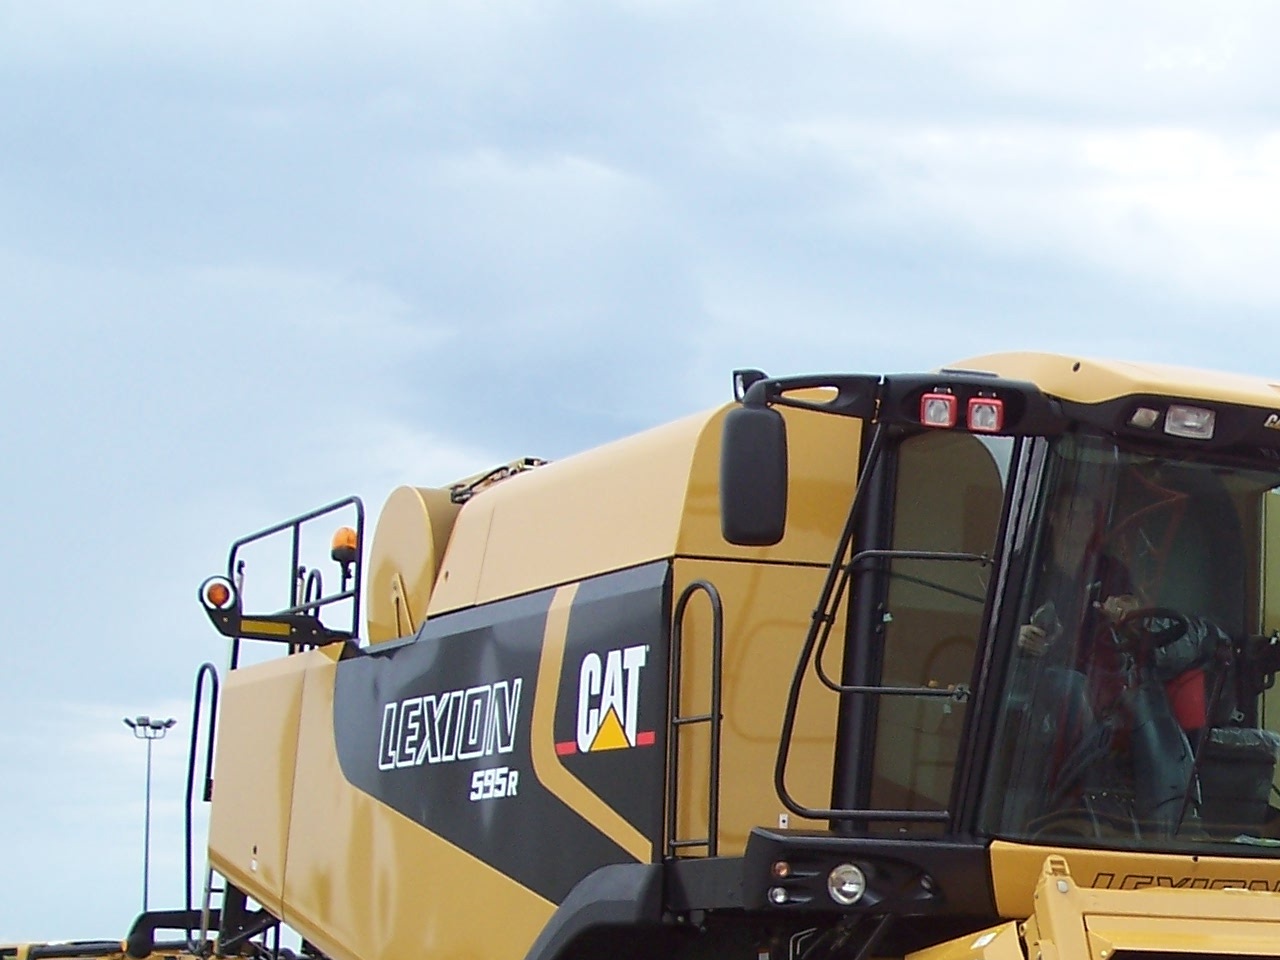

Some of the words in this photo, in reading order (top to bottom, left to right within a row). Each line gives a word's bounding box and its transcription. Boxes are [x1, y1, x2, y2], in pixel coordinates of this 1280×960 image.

[379, 678, 522, 770] LEXION
[576, 645, 646, 752] CAT
[470, 767, 518, 800] 595R
